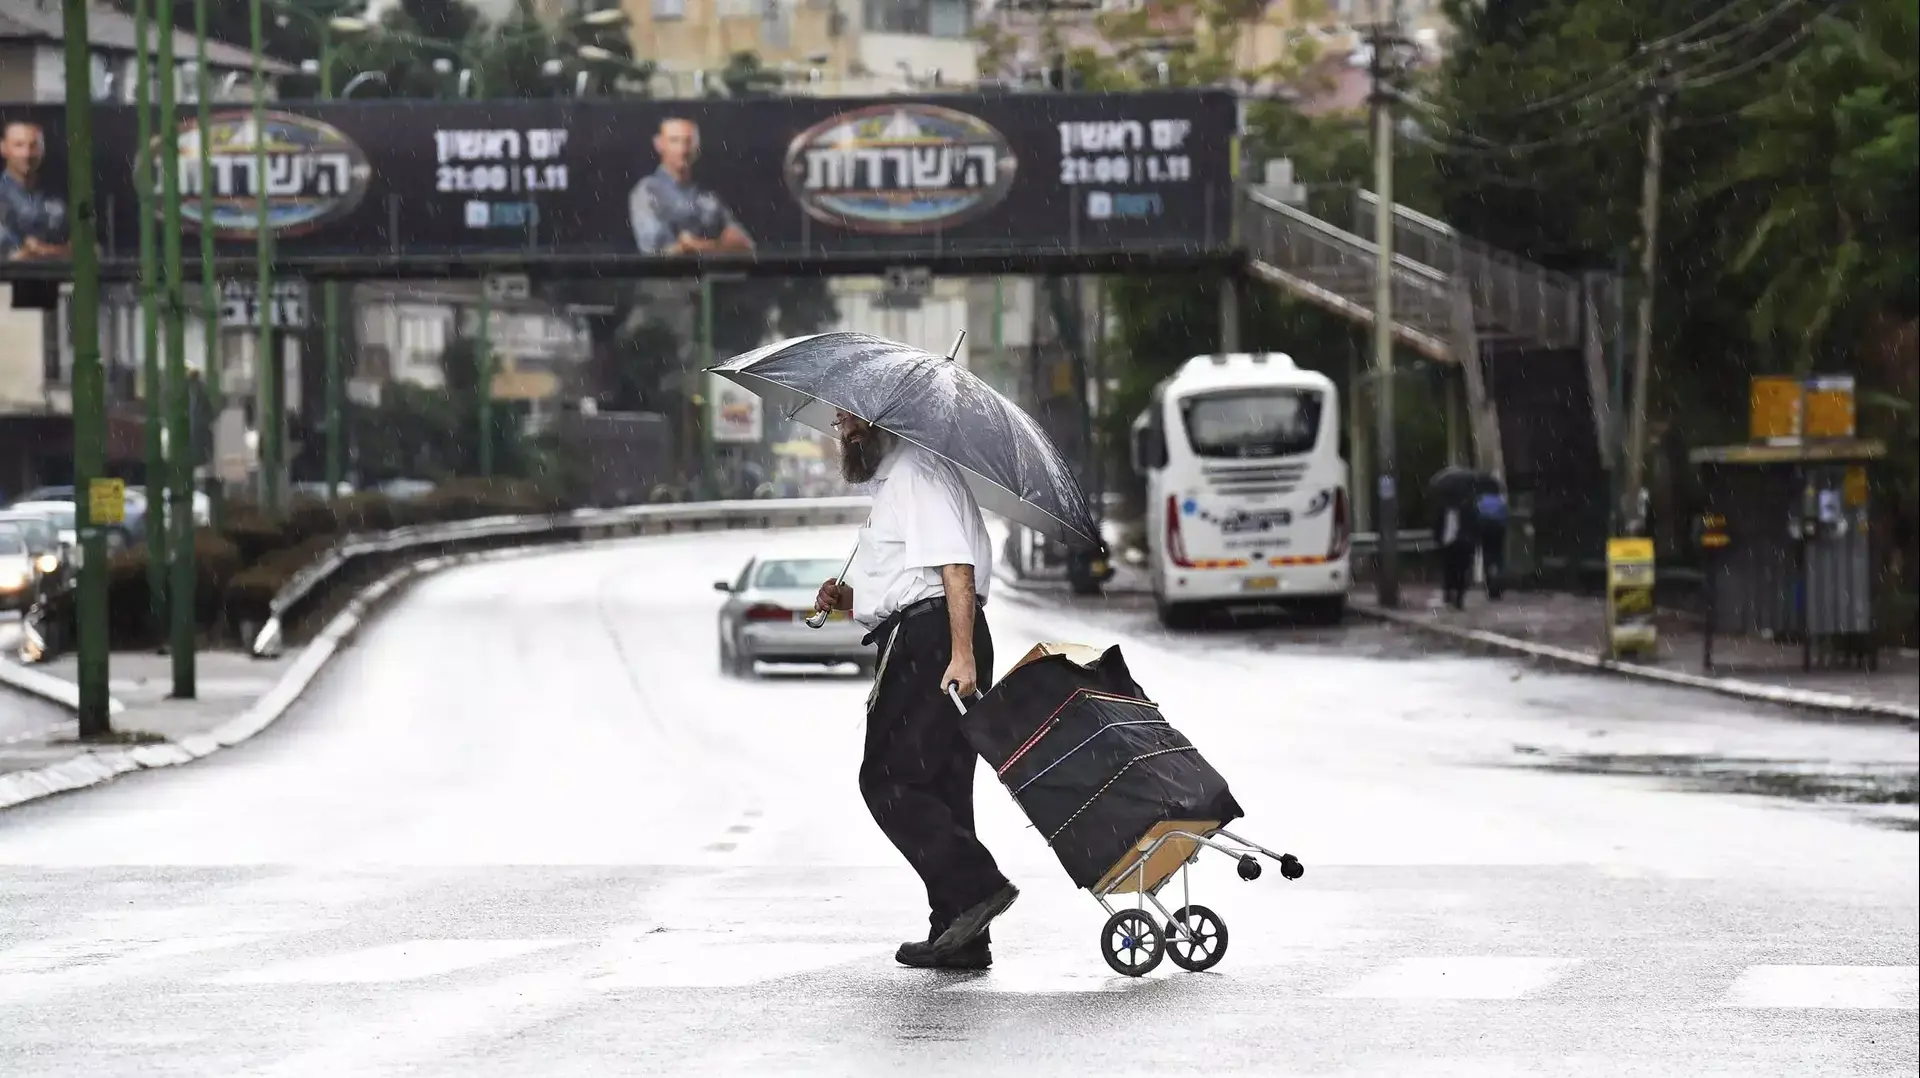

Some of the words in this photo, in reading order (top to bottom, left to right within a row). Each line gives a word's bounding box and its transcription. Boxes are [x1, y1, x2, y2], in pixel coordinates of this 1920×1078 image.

[435, 129, 520, 163] ראשון
[526, 129, 569, 160] יום
[1058, 120, 1143, 156] ראשון
[1149, 119, 1191, 150] יום
[436, 165, 507, 191] 21:00
[804, 145, 997, 189] הישרדות
[1060, 156, 1130, 184] 21:00
